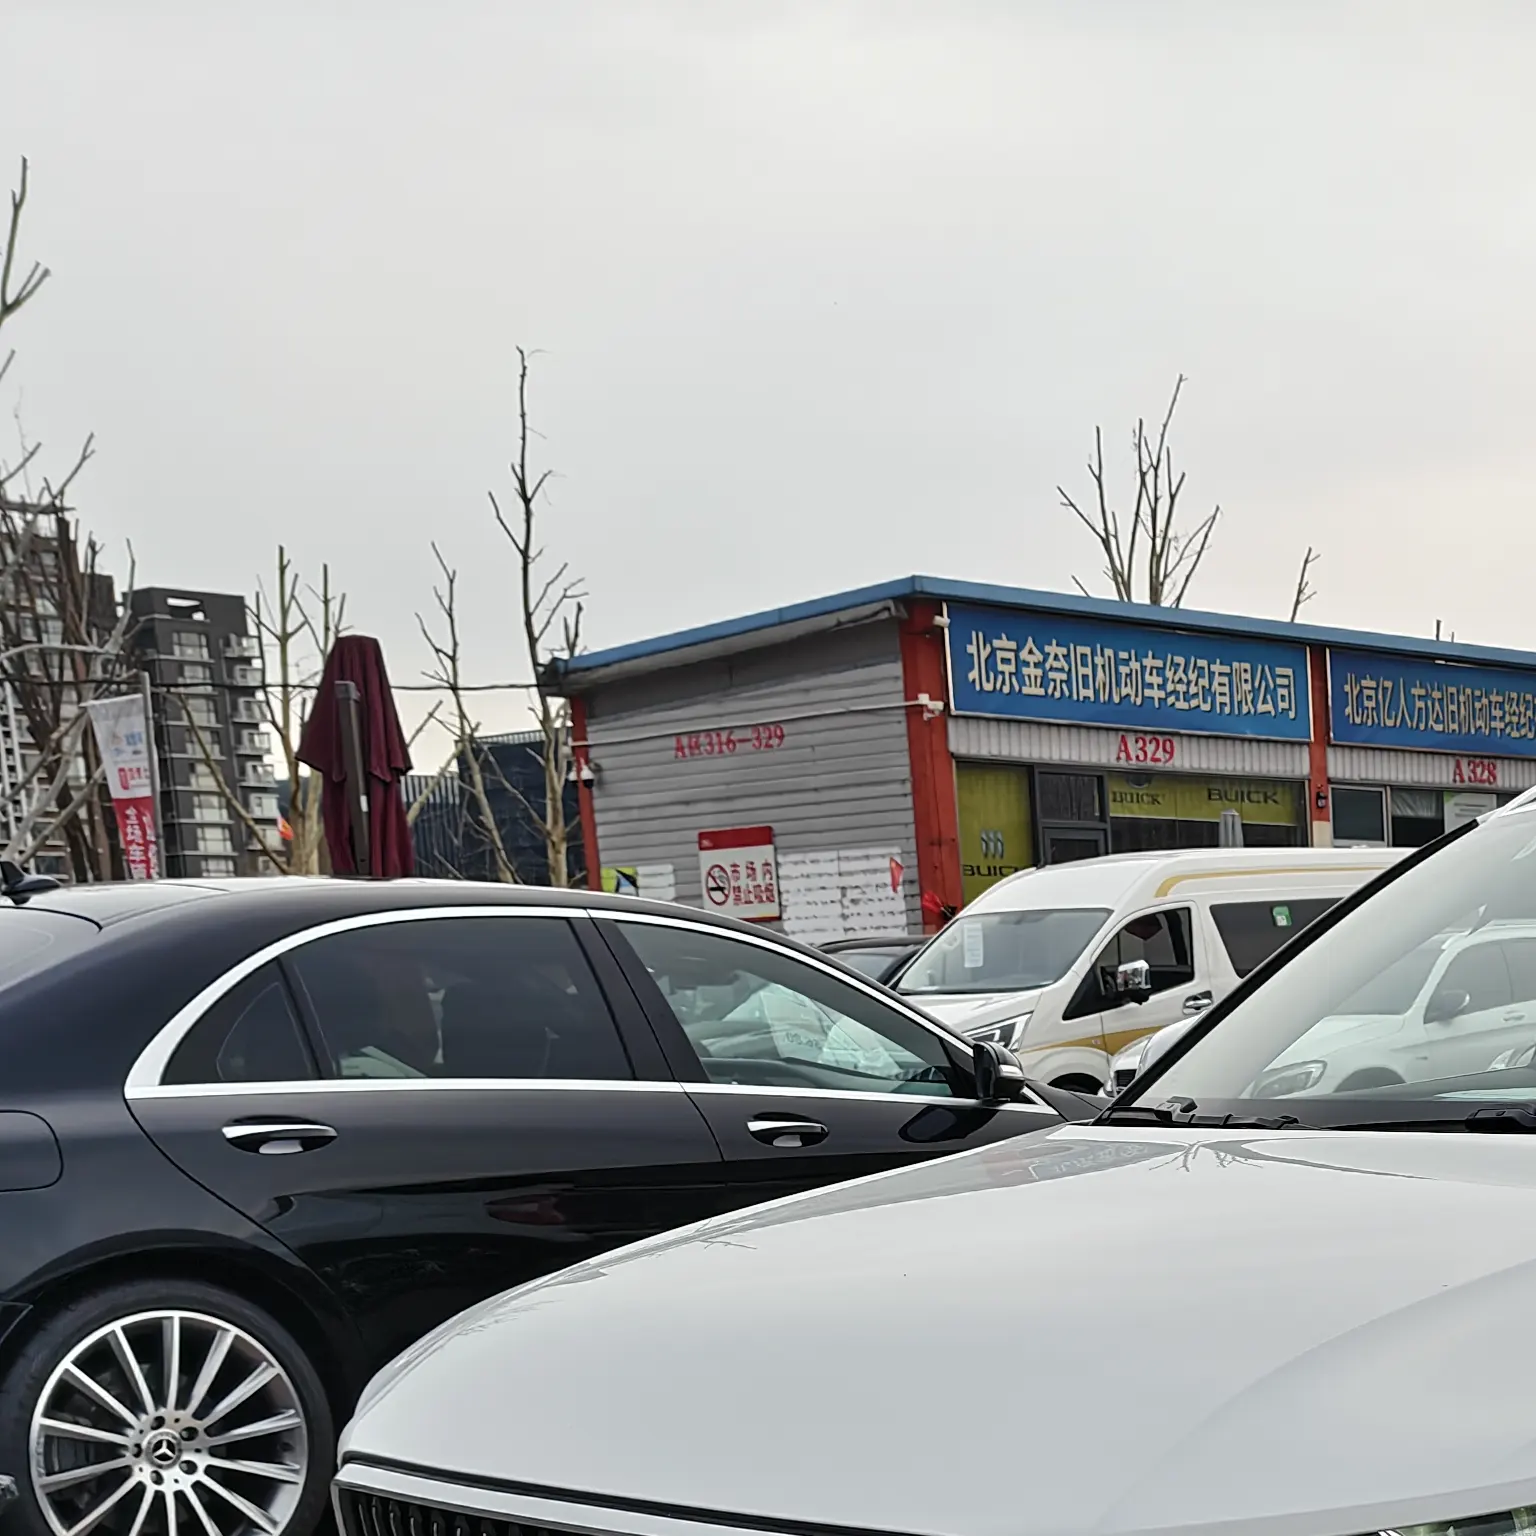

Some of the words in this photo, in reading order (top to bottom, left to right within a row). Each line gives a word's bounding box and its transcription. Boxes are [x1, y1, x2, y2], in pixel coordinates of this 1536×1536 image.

[966, 630, 1296, 720] 北京金奈旧机动车经纪有限公司
[1116, 734, 1175, 763] A329
[1112, 789, 1162, 806] BUICK
[1207, 788, 1281, 804] BUICK
[962, 864, 1024, 877] BUIC
